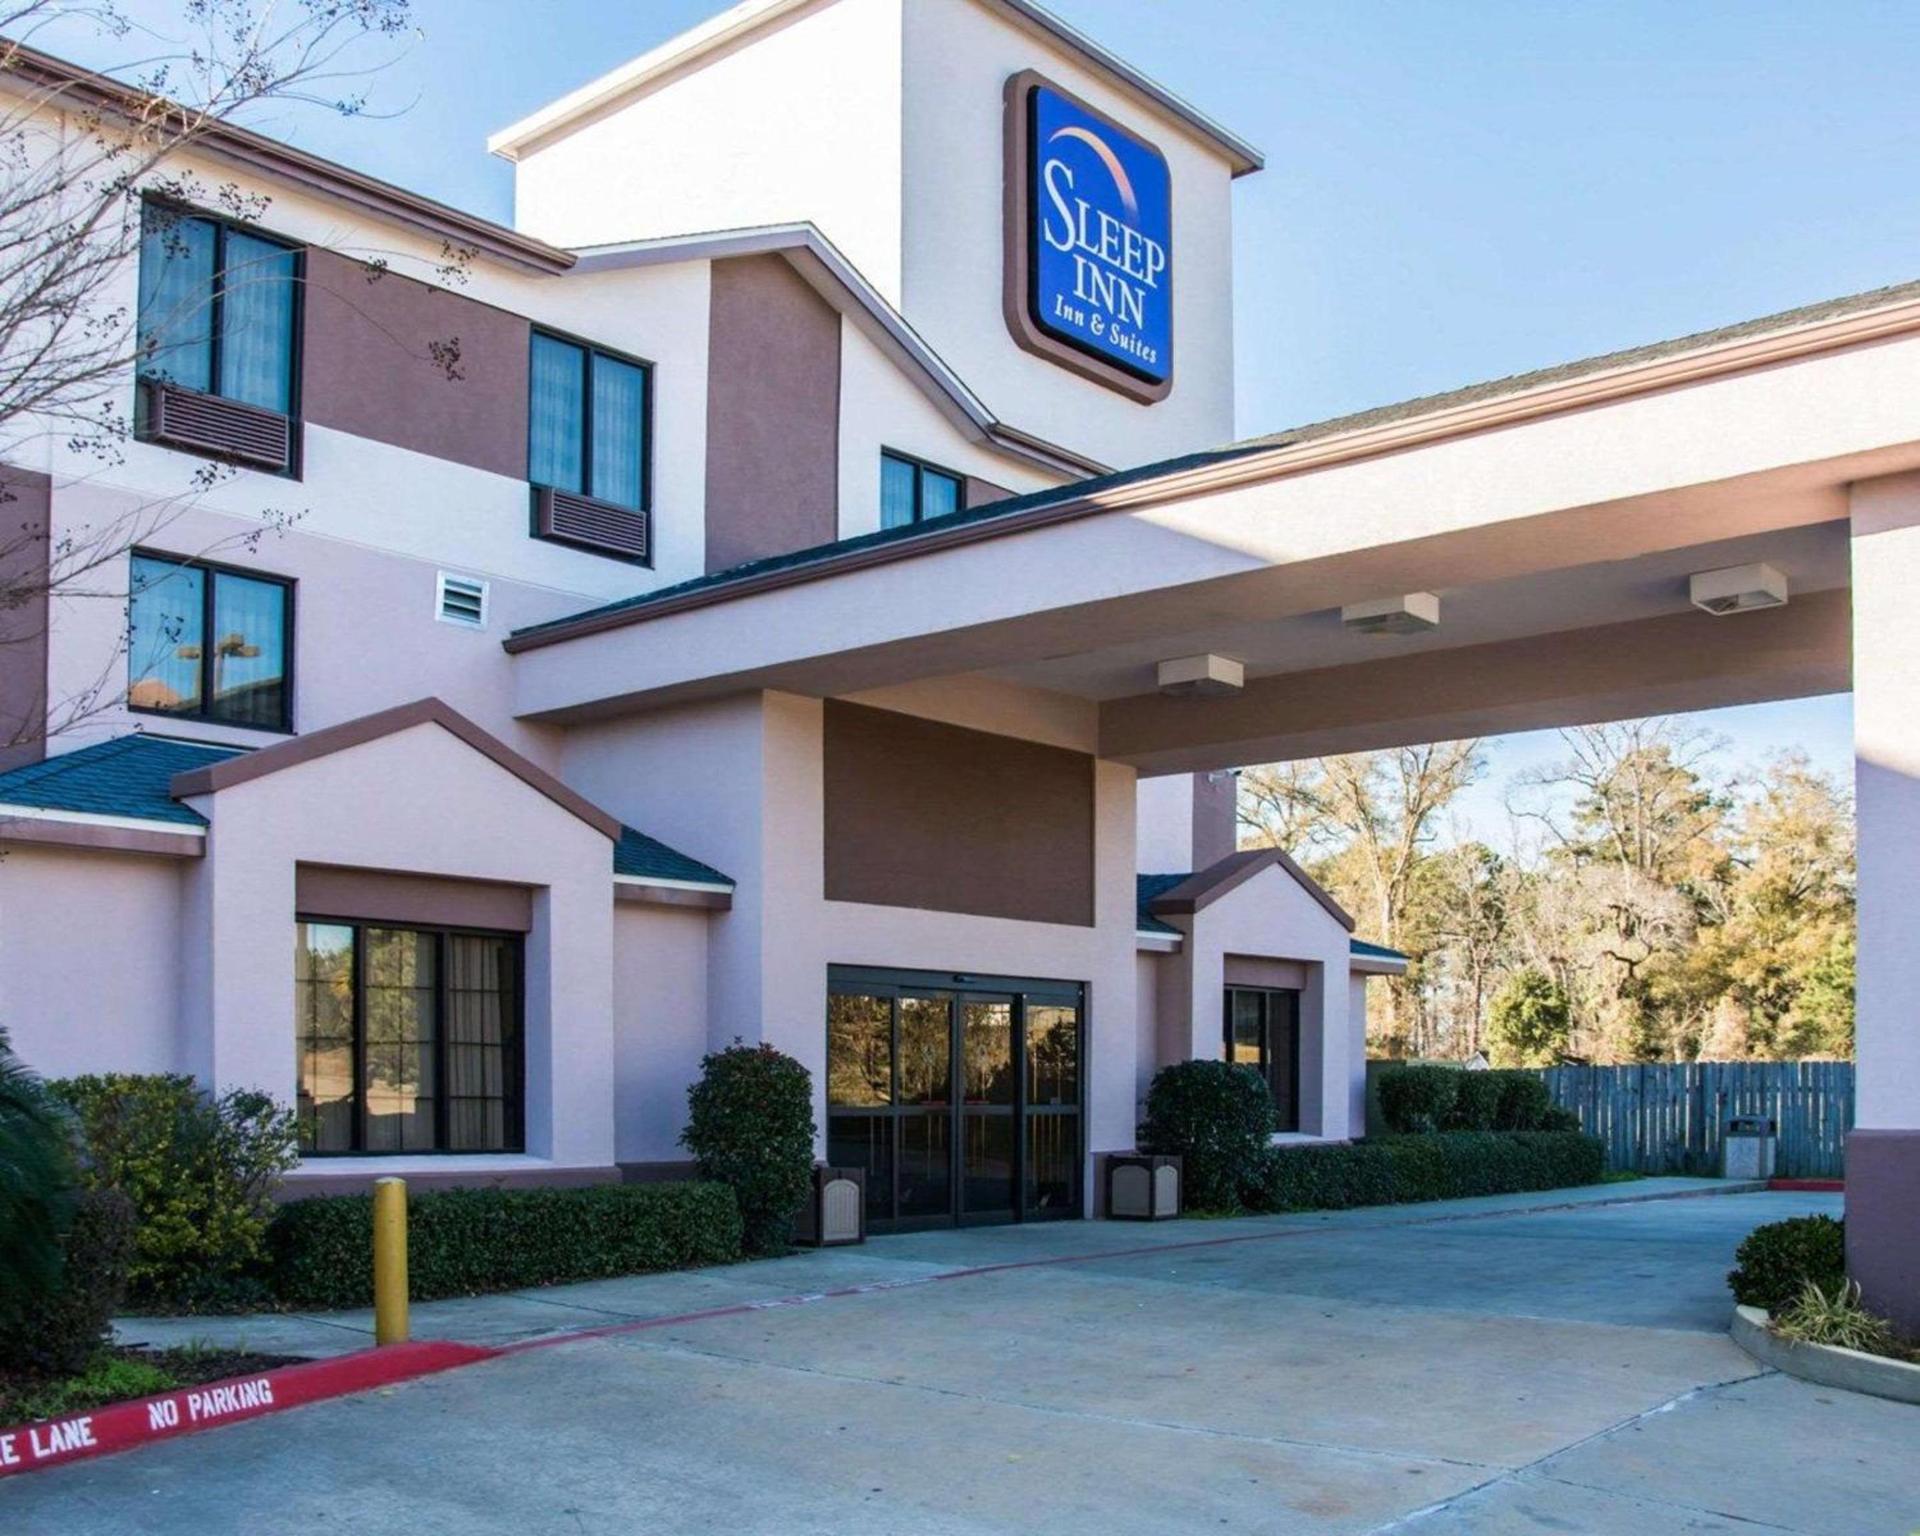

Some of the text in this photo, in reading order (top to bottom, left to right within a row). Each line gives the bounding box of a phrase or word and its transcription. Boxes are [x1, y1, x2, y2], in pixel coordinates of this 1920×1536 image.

[1044, 159, 1165, 288] SLEEP
[1073, 254, 1145, 330] INN
[1055, 294, 1157, 363] Inn & Suites
[148, 1378, 273, 1430] NO PARKING
[0, 1416, 97, 1466] E LANE
